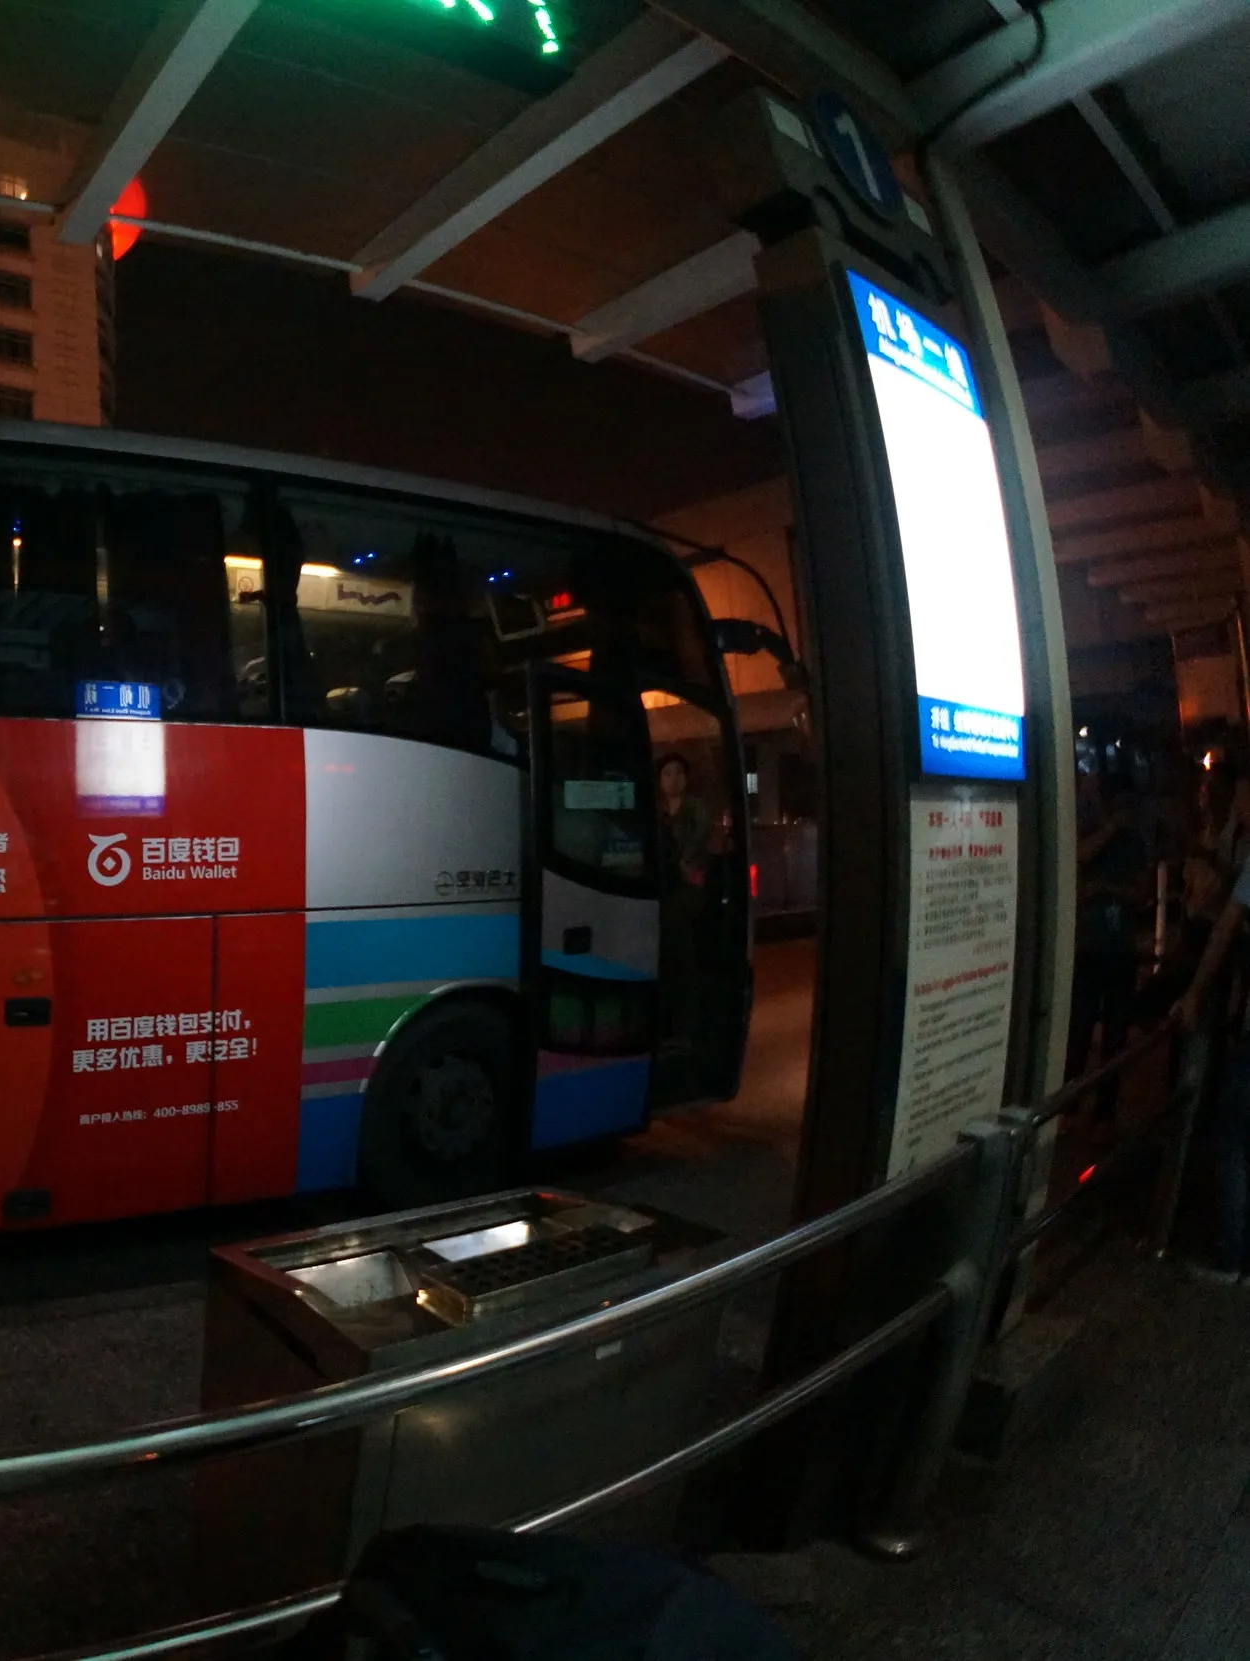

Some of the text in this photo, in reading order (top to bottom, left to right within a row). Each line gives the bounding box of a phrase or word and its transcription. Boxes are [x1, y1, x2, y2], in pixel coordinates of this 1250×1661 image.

[142, 837, 240, 863] 百度钱包
[142, 865, 237, 881] Baidu Wallet
